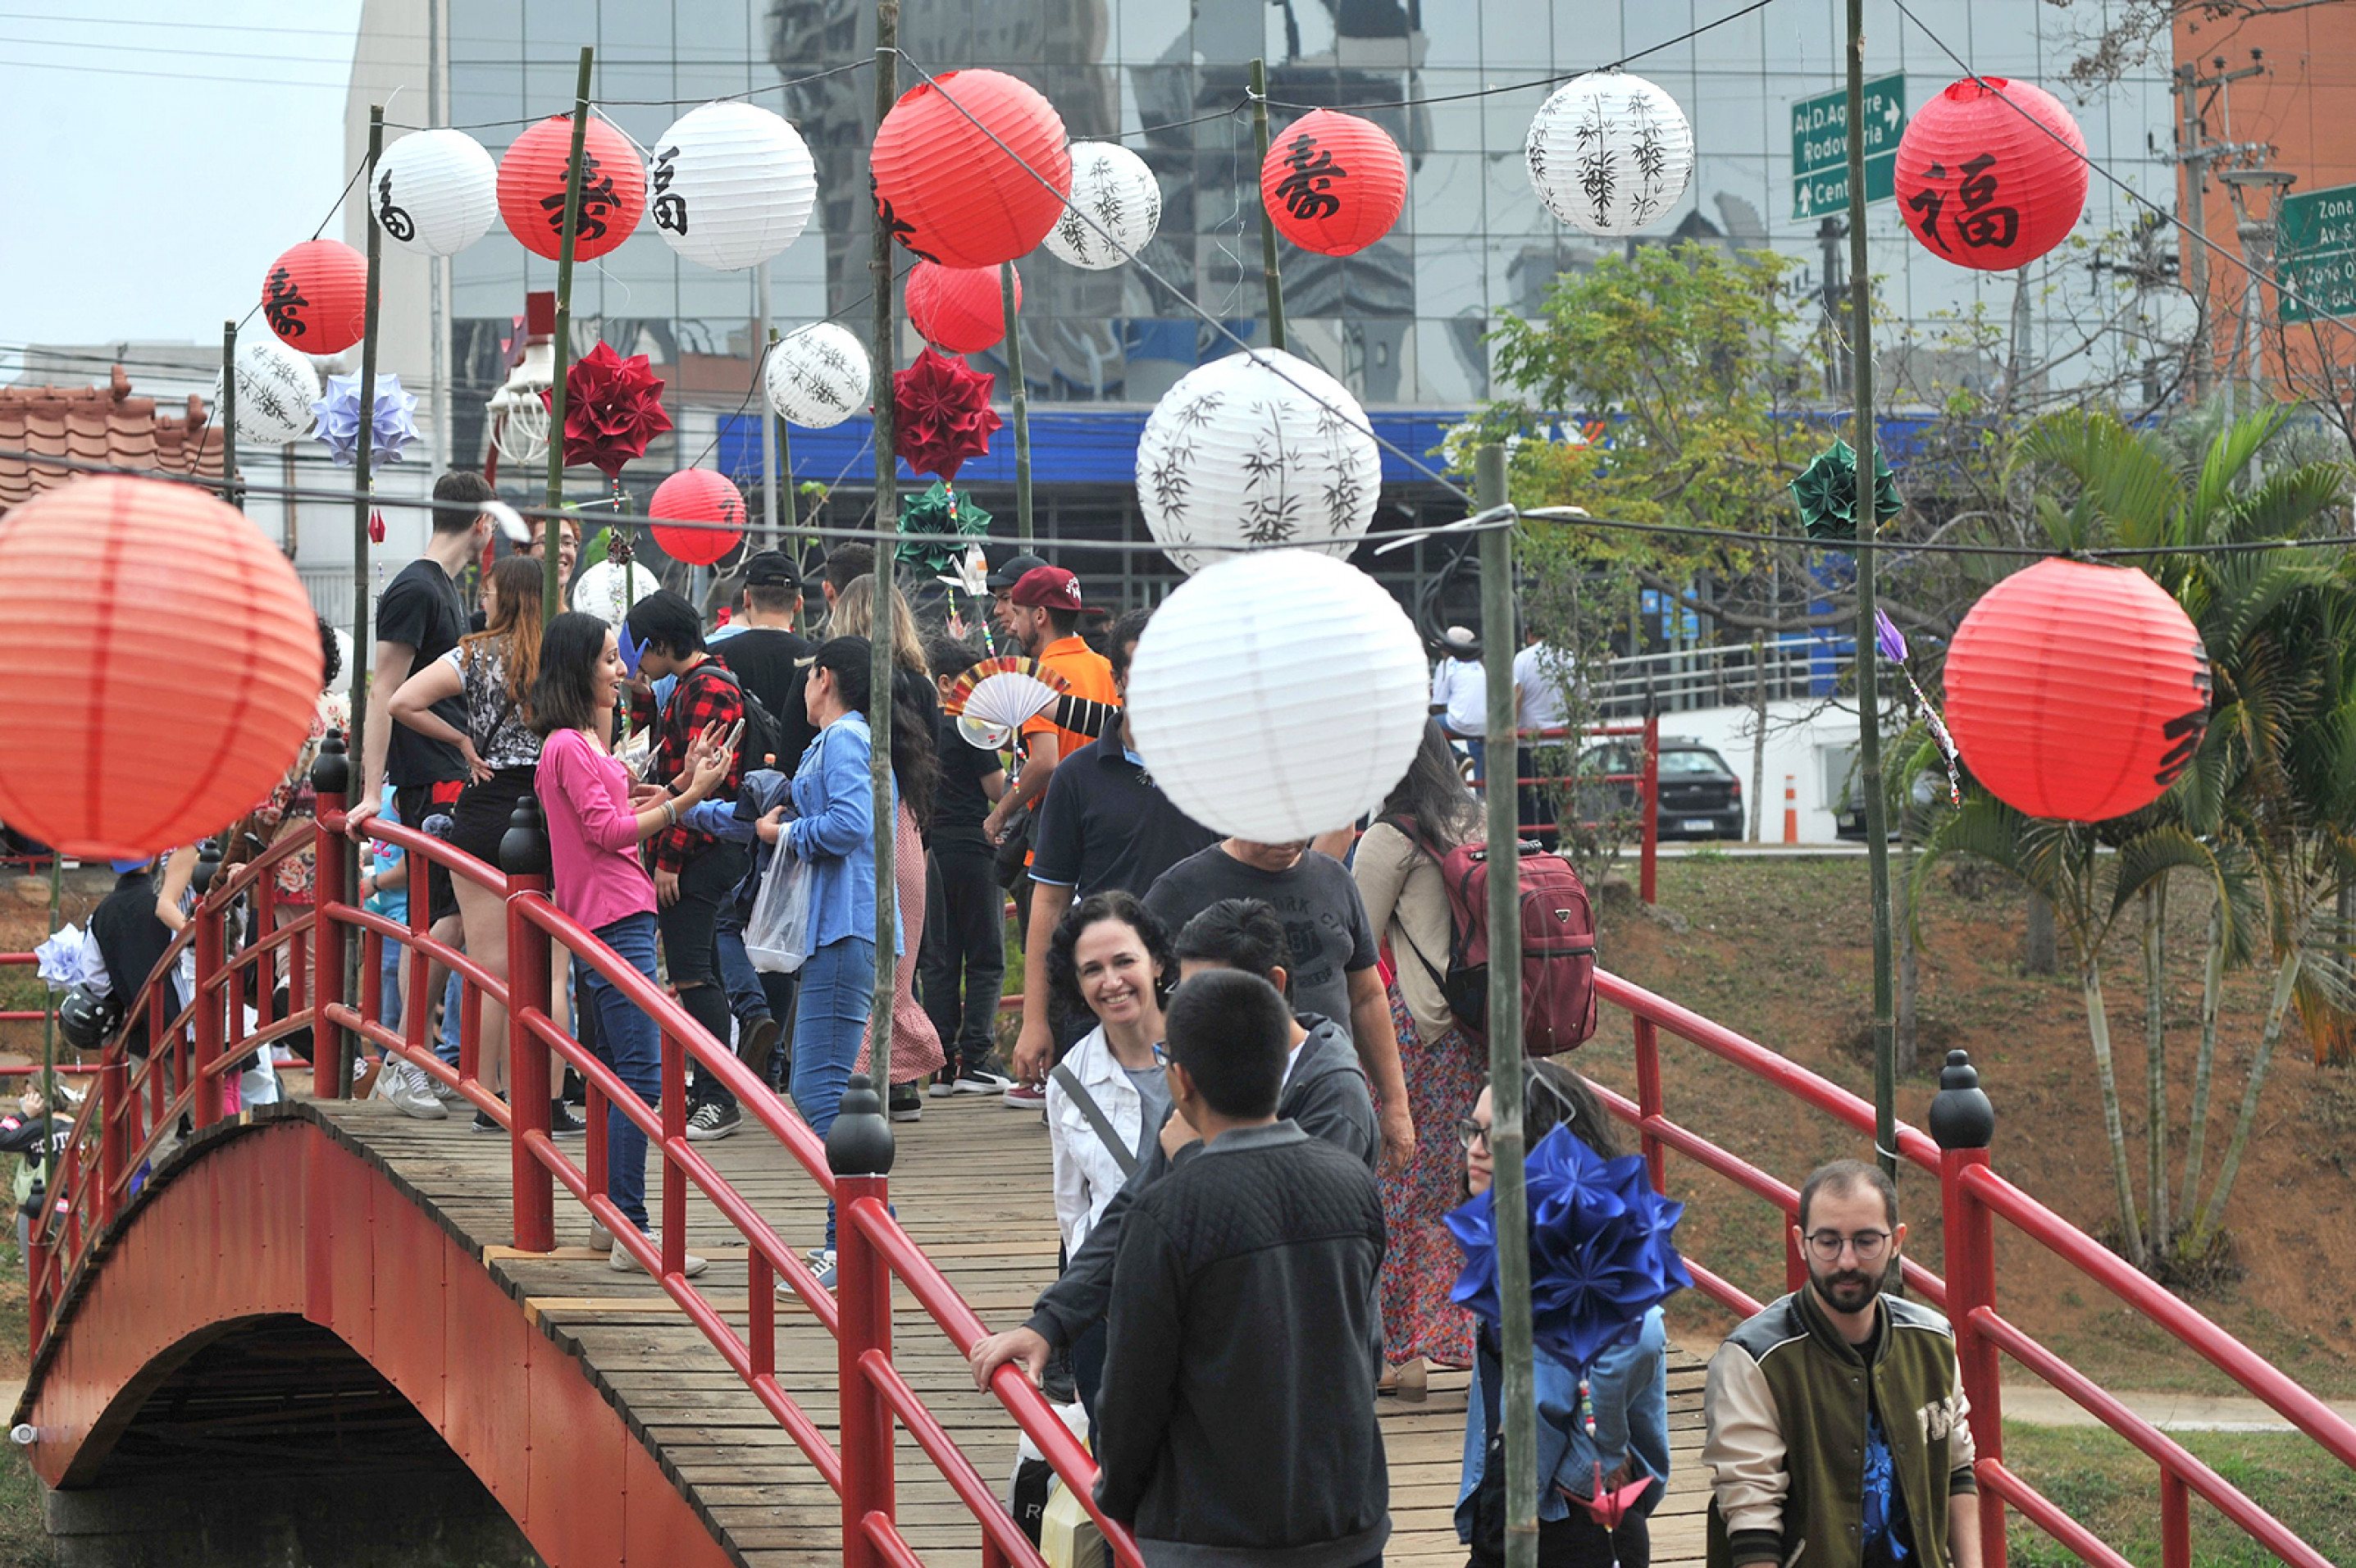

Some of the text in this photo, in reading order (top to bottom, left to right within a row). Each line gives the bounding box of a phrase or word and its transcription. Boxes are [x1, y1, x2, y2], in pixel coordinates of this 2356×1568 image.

[1803, 123, 1883, 162] Rodovria
[1815, 180, 1850, 204] Cent
[1907, 153, 2020, 254] 福
